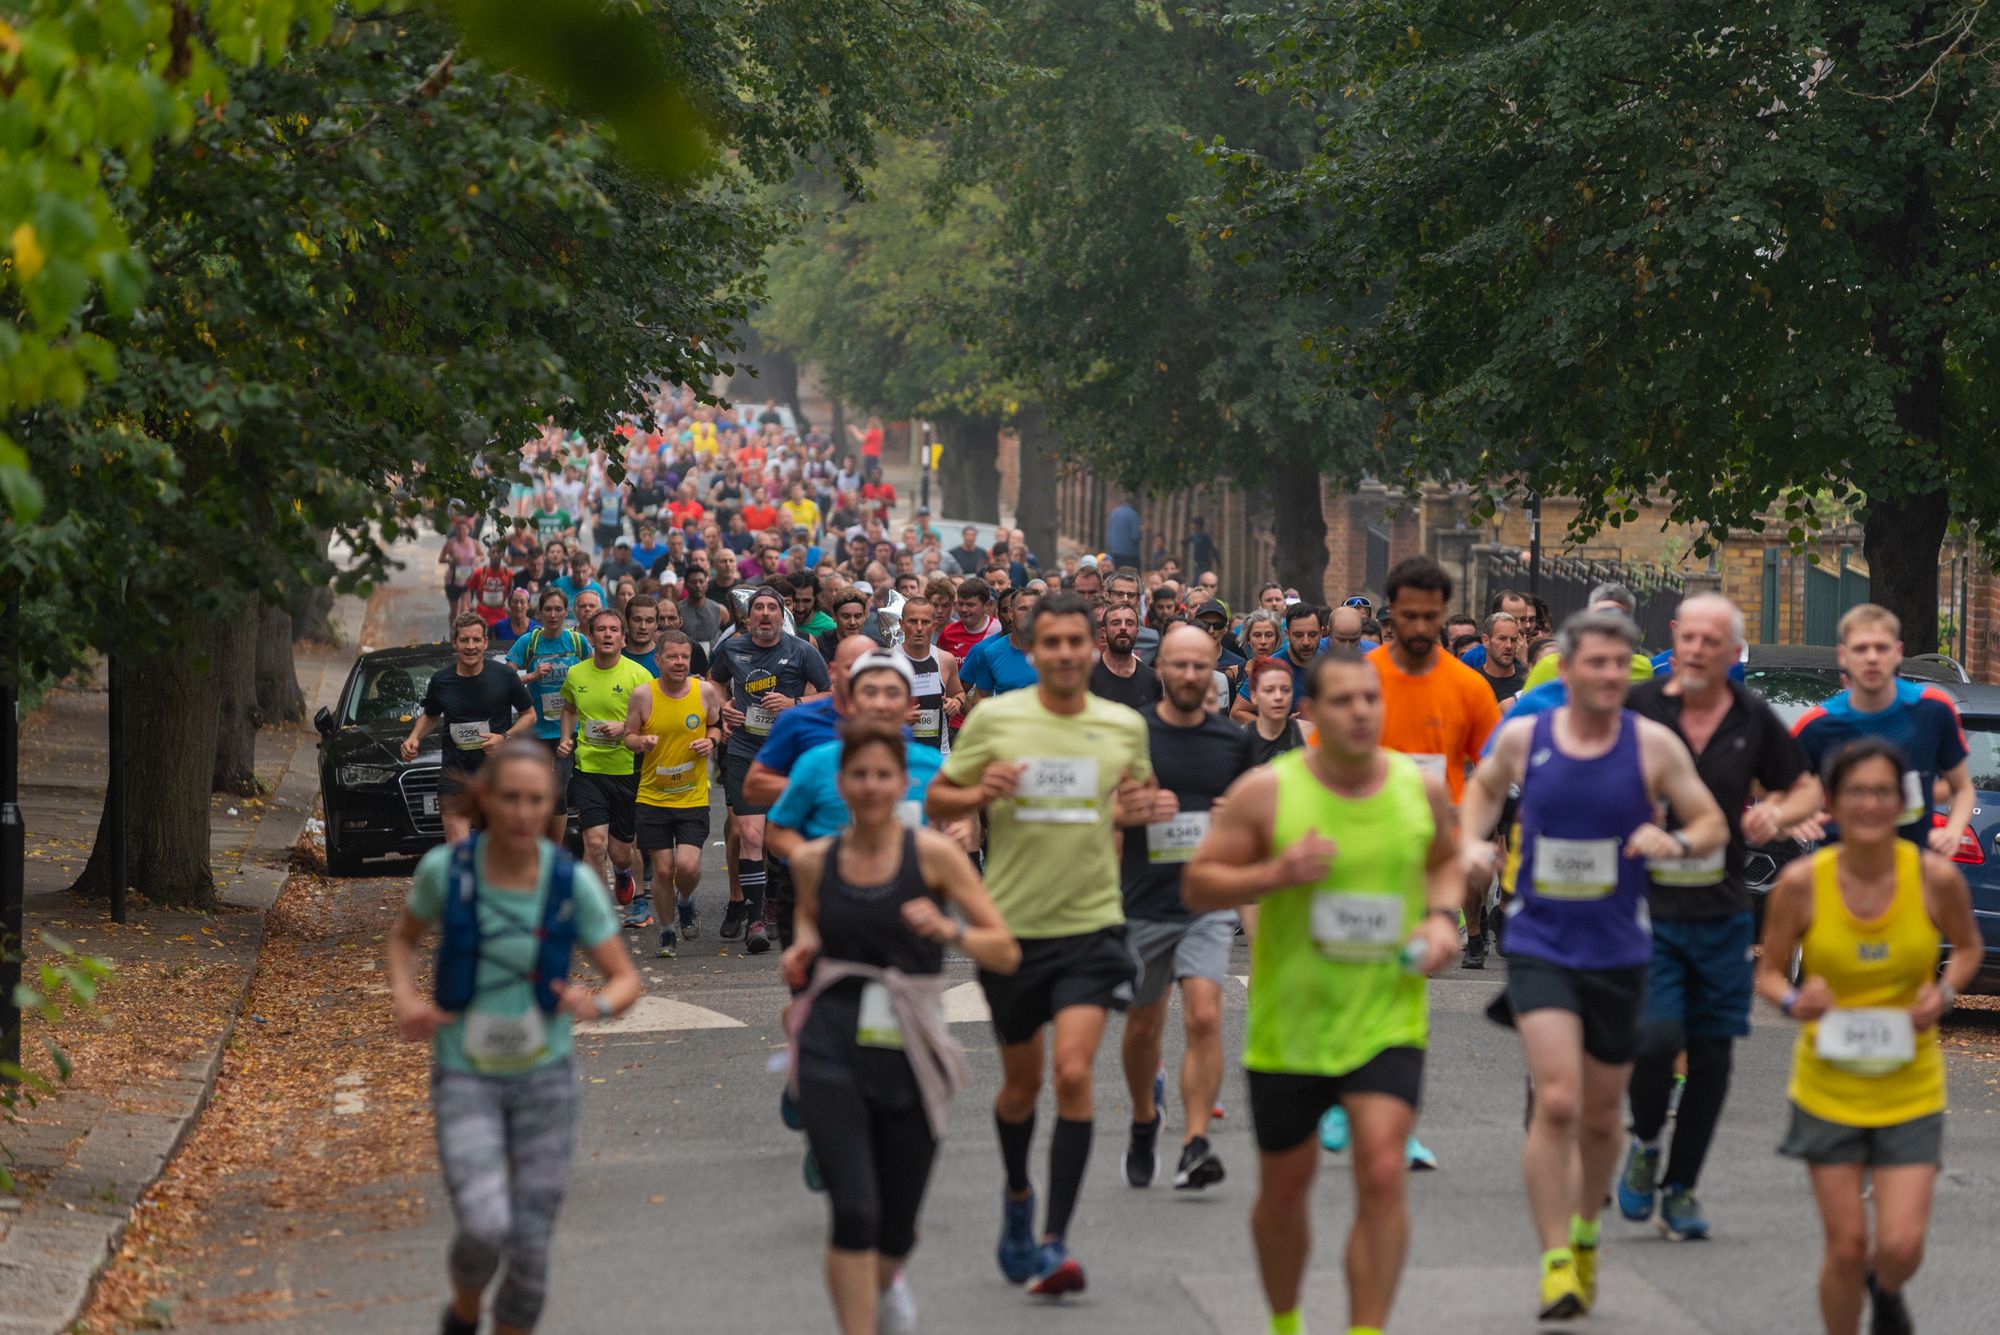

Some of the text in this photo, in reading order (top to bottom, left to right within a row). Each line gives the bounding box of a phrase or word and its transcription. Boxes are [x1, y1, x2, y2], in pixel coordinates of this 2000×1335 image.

[745, 675, 776, 694] FINISHER
[918, 717, 931, 725] 98
[459, 730, 480, 738] 3295
